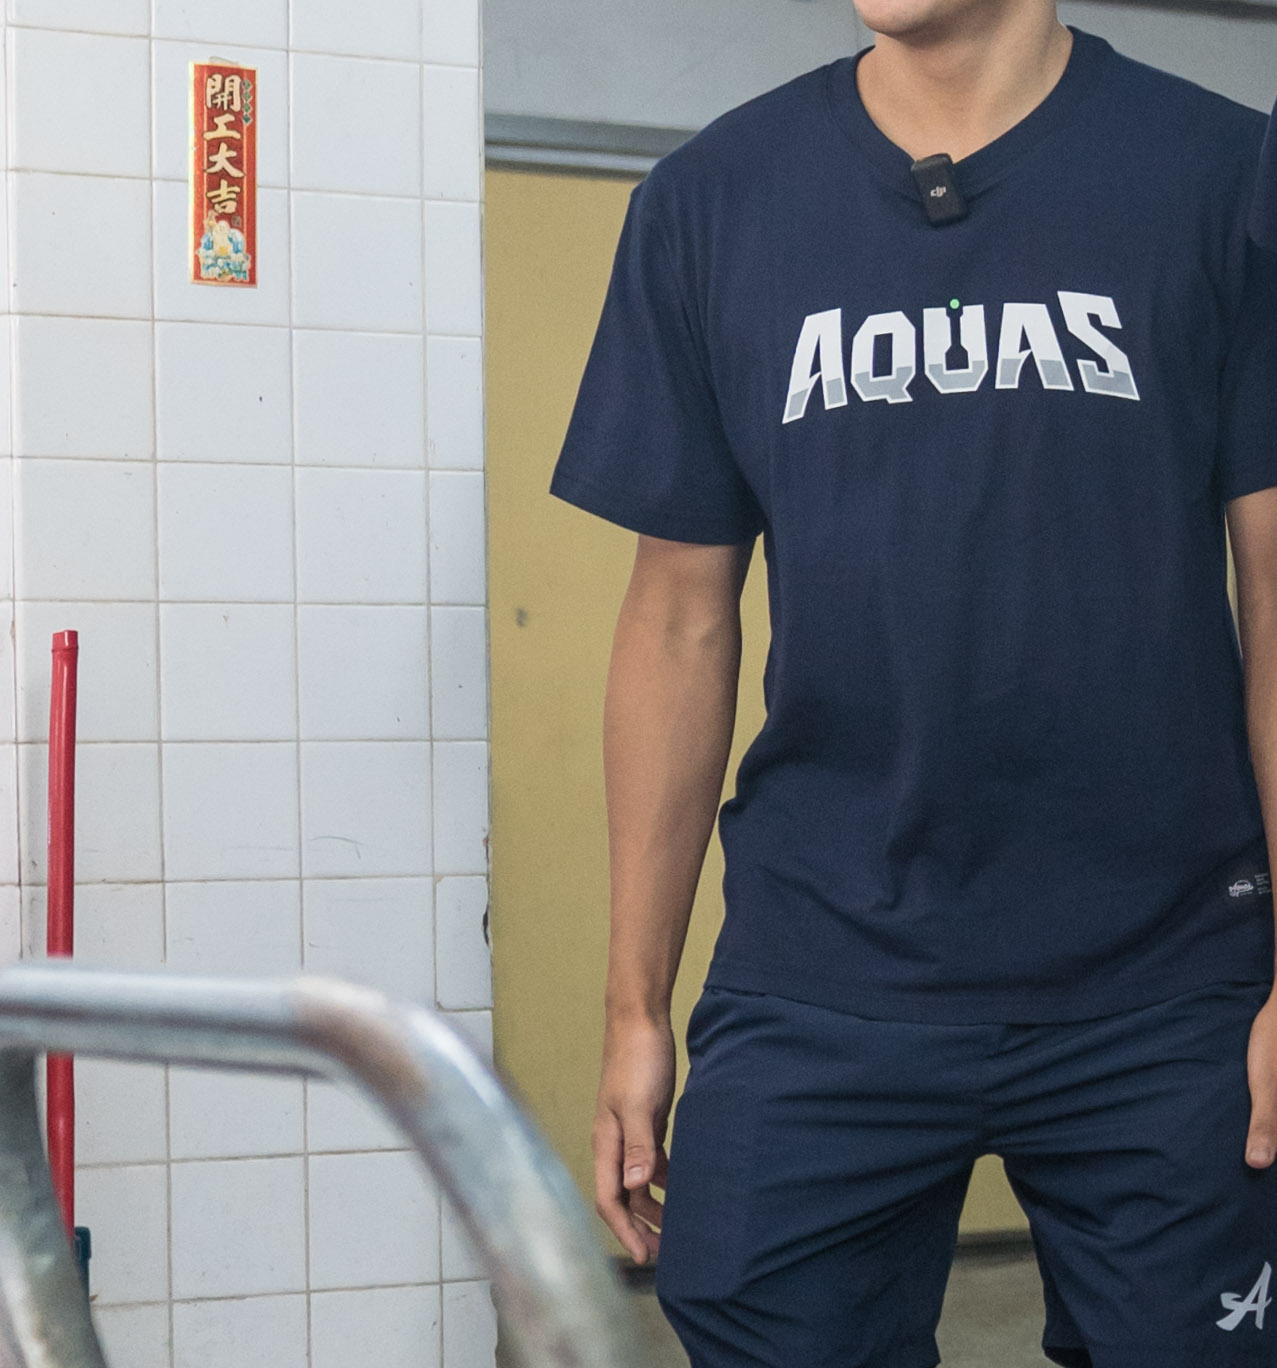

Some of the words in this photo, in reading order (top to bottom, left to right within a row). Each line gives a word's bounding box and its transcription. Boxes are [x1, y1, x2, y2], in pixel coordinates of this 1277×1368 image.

[203, 73, 246, 216] 開工大吉
[782, 290, 1141, 425] AQUAS
